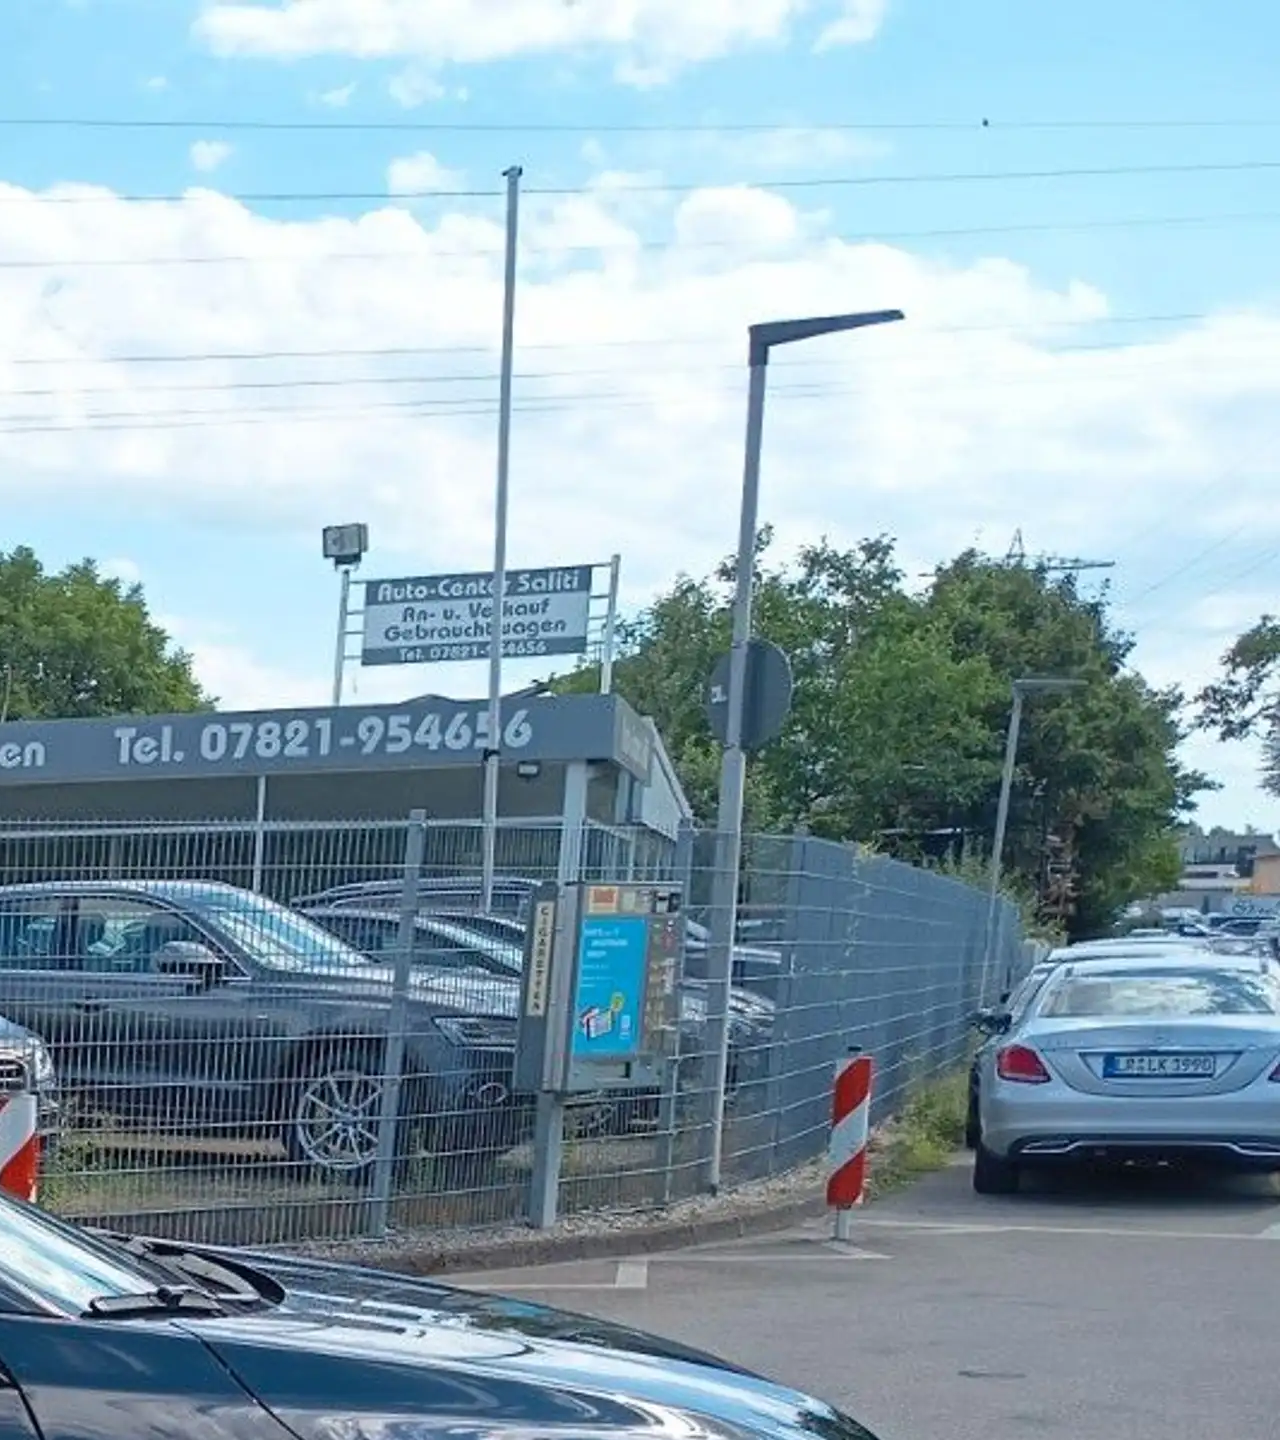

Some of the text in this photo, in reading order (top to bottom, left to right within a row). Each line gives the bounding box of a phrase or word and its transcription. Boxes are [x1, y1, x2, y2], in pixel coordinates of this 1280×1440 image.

[516, 569, 580, 593] Saliti
[401, 598, 550, 623] An- u. Vekauf
[114, 725, 185, 765] Tel.
